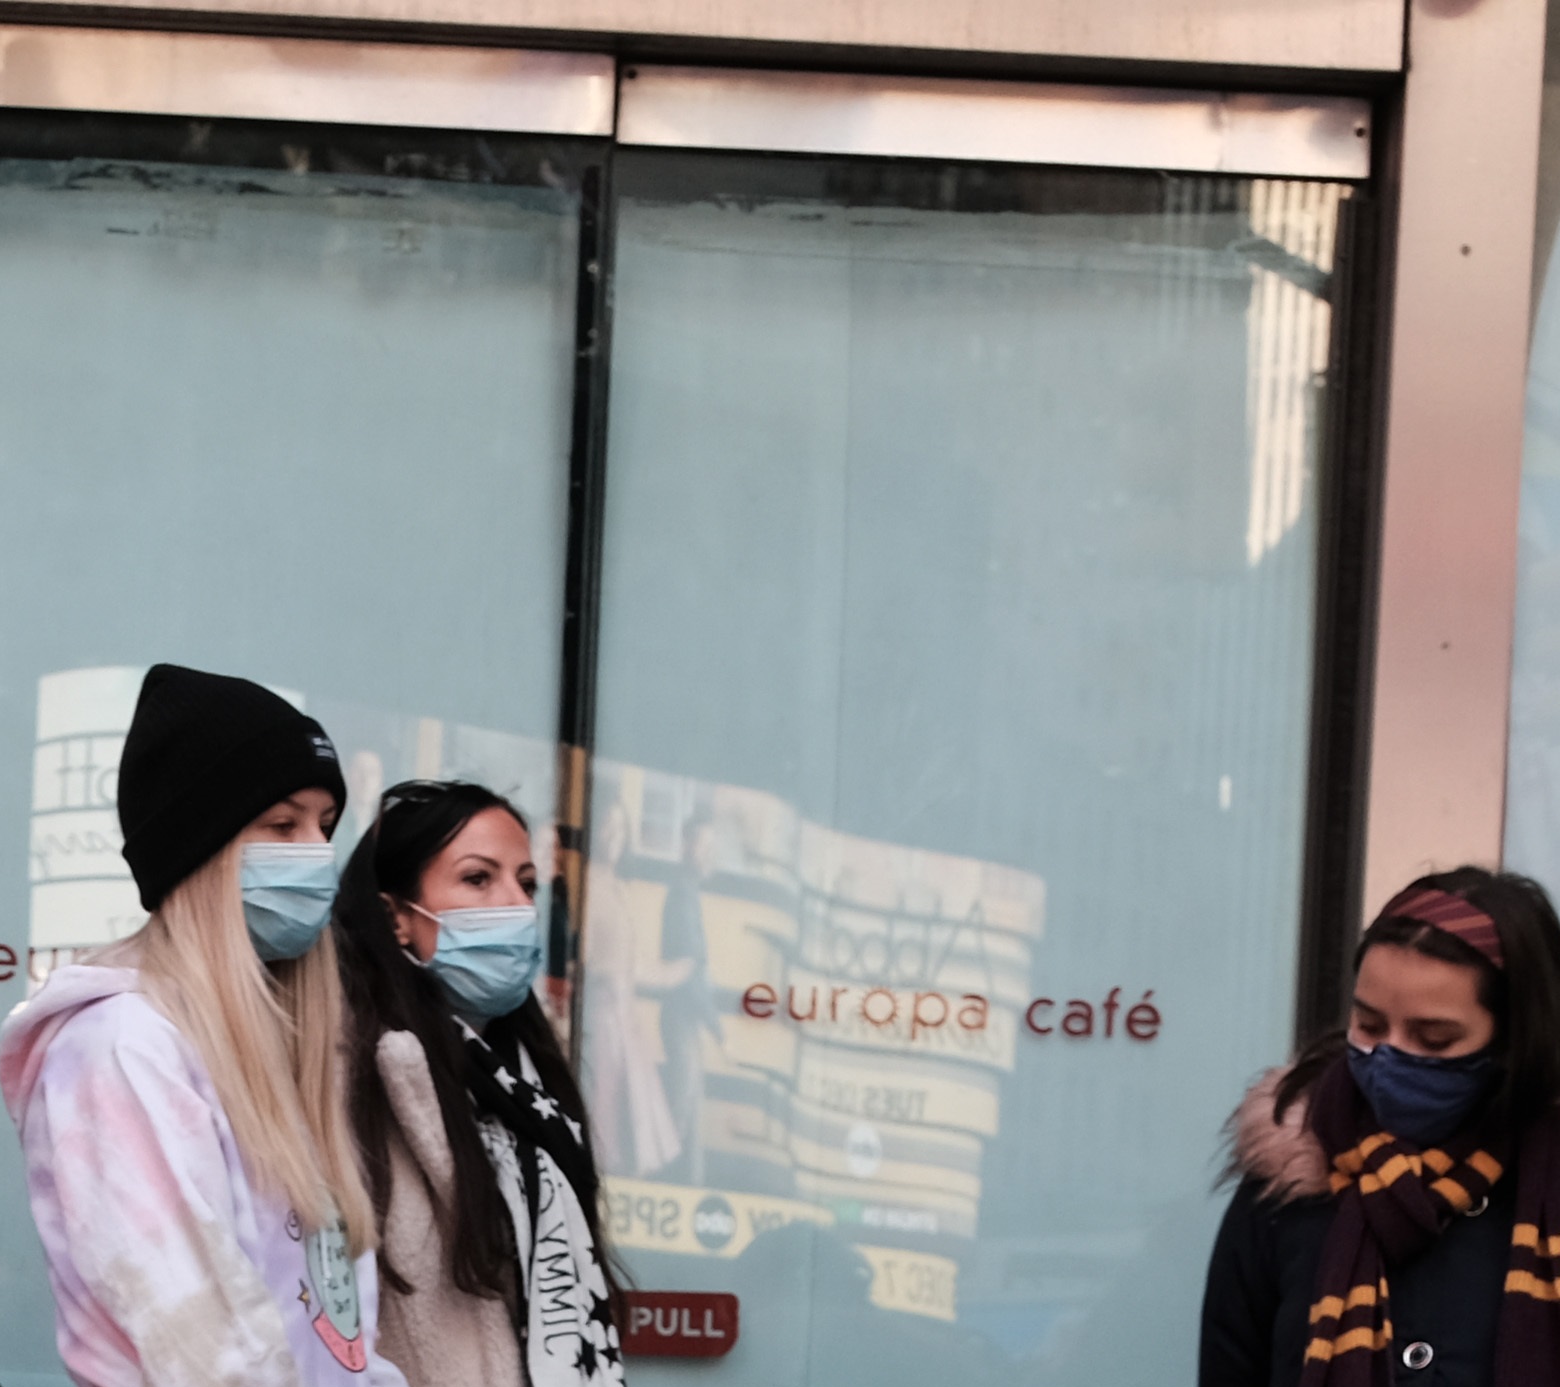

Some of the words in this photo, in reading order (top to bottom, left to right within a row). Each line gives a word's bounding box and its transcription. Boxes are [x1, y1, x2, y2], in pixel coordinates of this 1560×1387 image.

[740, 981, 992, 1041] europa
[1025, 986, 1164, 1042] café
[630, 1307, 726, 1339] PULL
